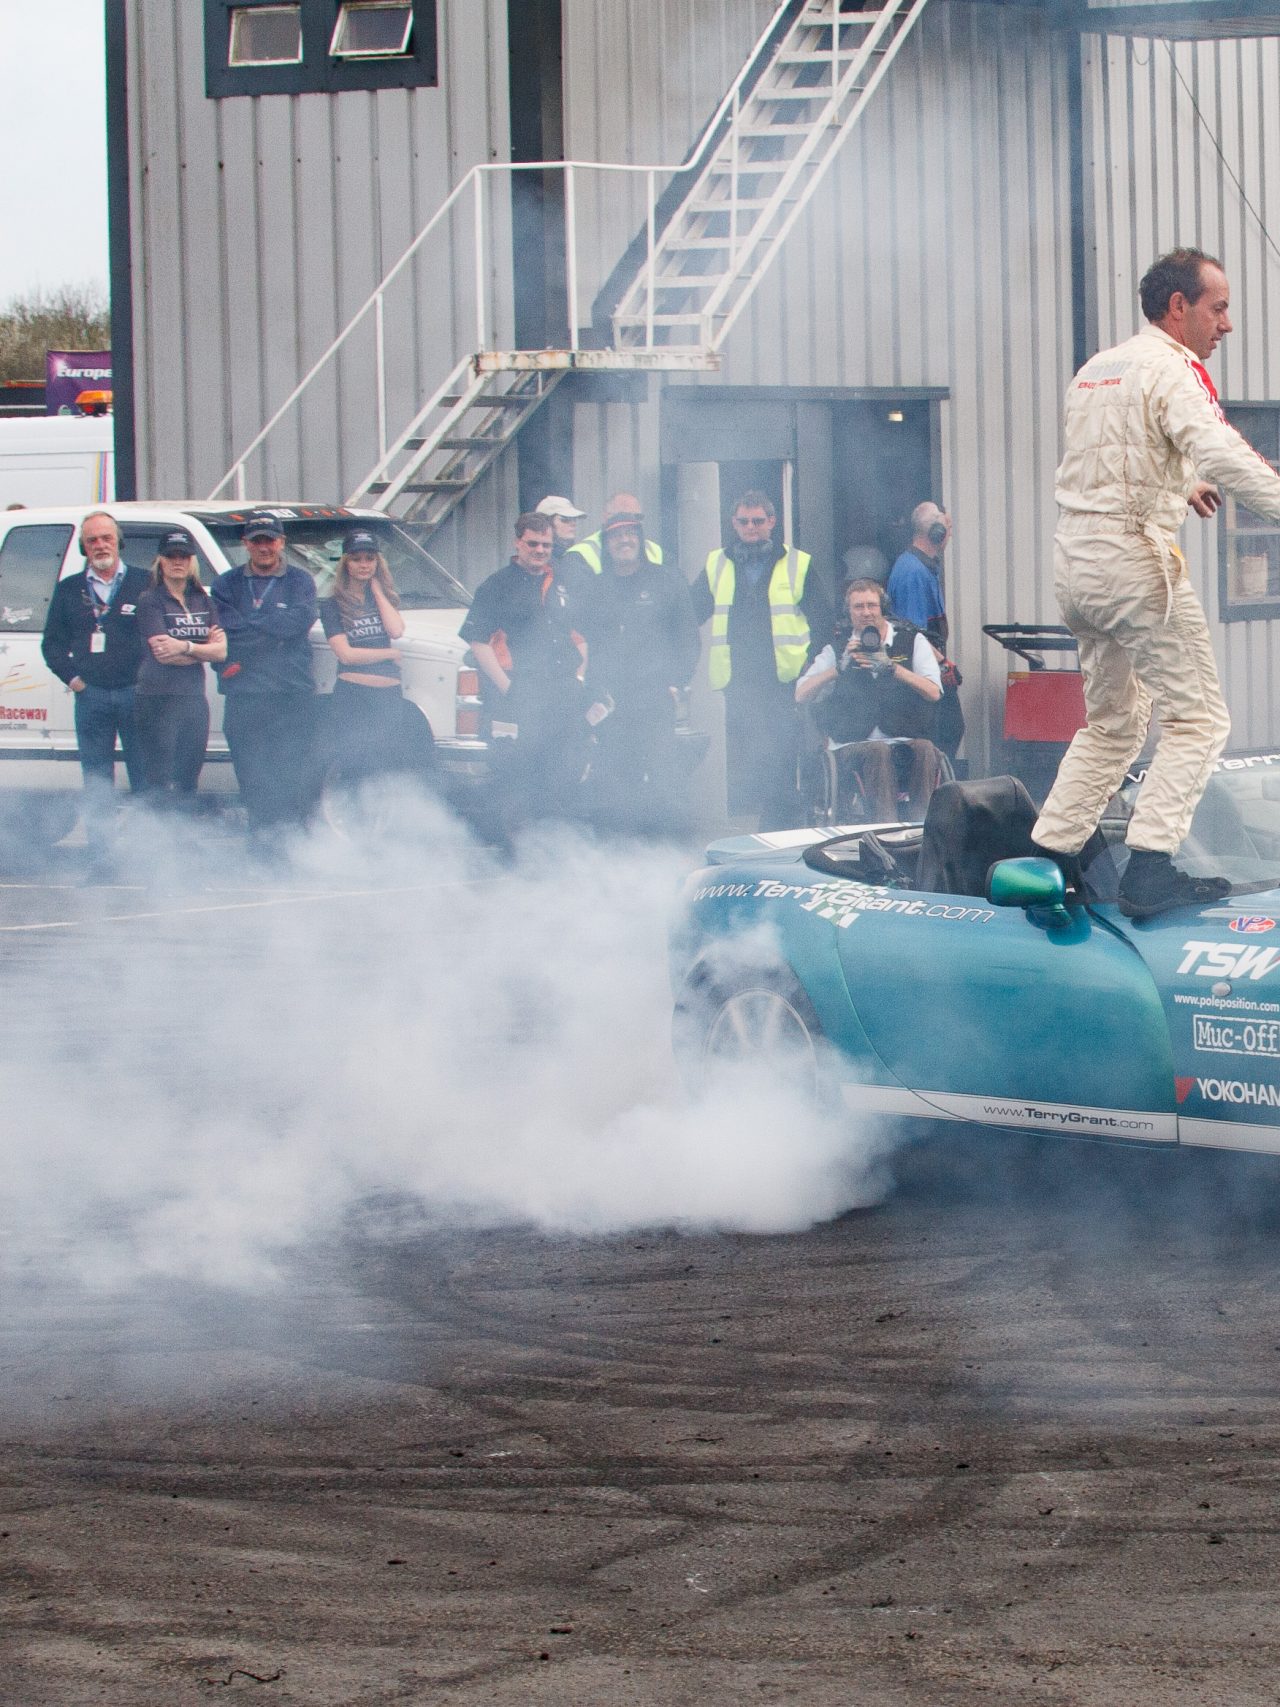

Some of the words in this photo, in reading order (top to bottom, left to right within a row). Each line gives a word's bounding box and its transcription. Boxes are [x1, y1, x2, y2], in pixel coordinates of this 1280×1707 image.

[175, 616, 205, 626] POLE
[0, 706, 47, 721] Raceway
[694, 880, 995, 923] www.TerryGrant.com
[1174, 994, 1280, 1012] www.poleposition.com
[1198, 1021, 1278, 1052] Muc-Off
[983, 1105, 1154, 1130] www.TerryGrant.com
